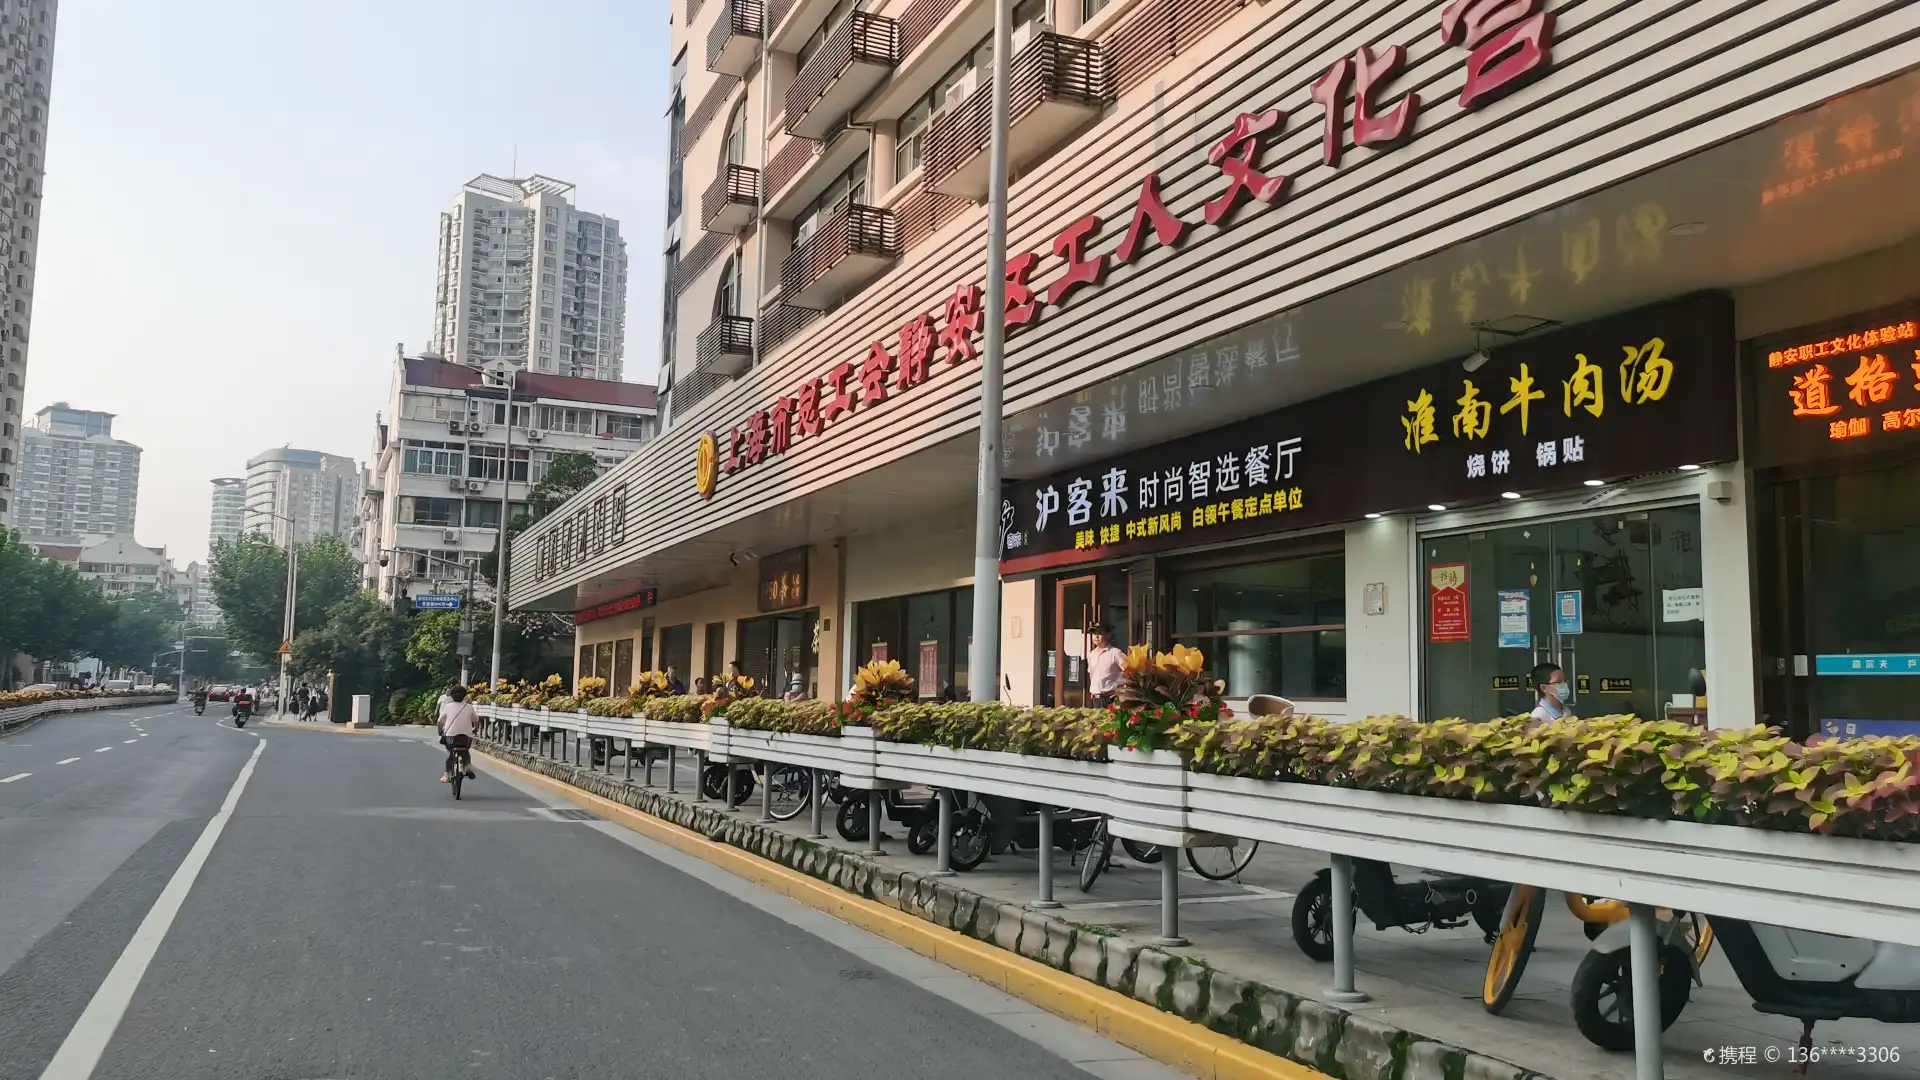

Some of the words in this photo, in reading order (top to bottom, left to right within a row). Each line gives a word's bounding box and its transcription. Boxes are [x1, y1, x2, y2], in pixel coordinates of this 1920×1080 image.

[1768, 320, 1917, 369] 静安职工文化体验站
[1400, 336, 1675, 454] 淮南牛肉汤
[1788, 348, 1920, 418] 道格
[1466, 448, 1511, 478] 烧饼
[1535, 435, 1585, 467] 锅贴
[1829, 417, 1871, 440] 瑜伽
[1035, 466, 1129, 533] 沪客来
[1138, 436, 1303, 508] 时尚智选餐厅
[1074, 527, 1095, 549] 美味
[1099, 523, 1120, 544] 快捷
[1125, 510, 1182, 540] 中式新风尚
[1192, 487, 1304, 528] 白领午餐定点单位
